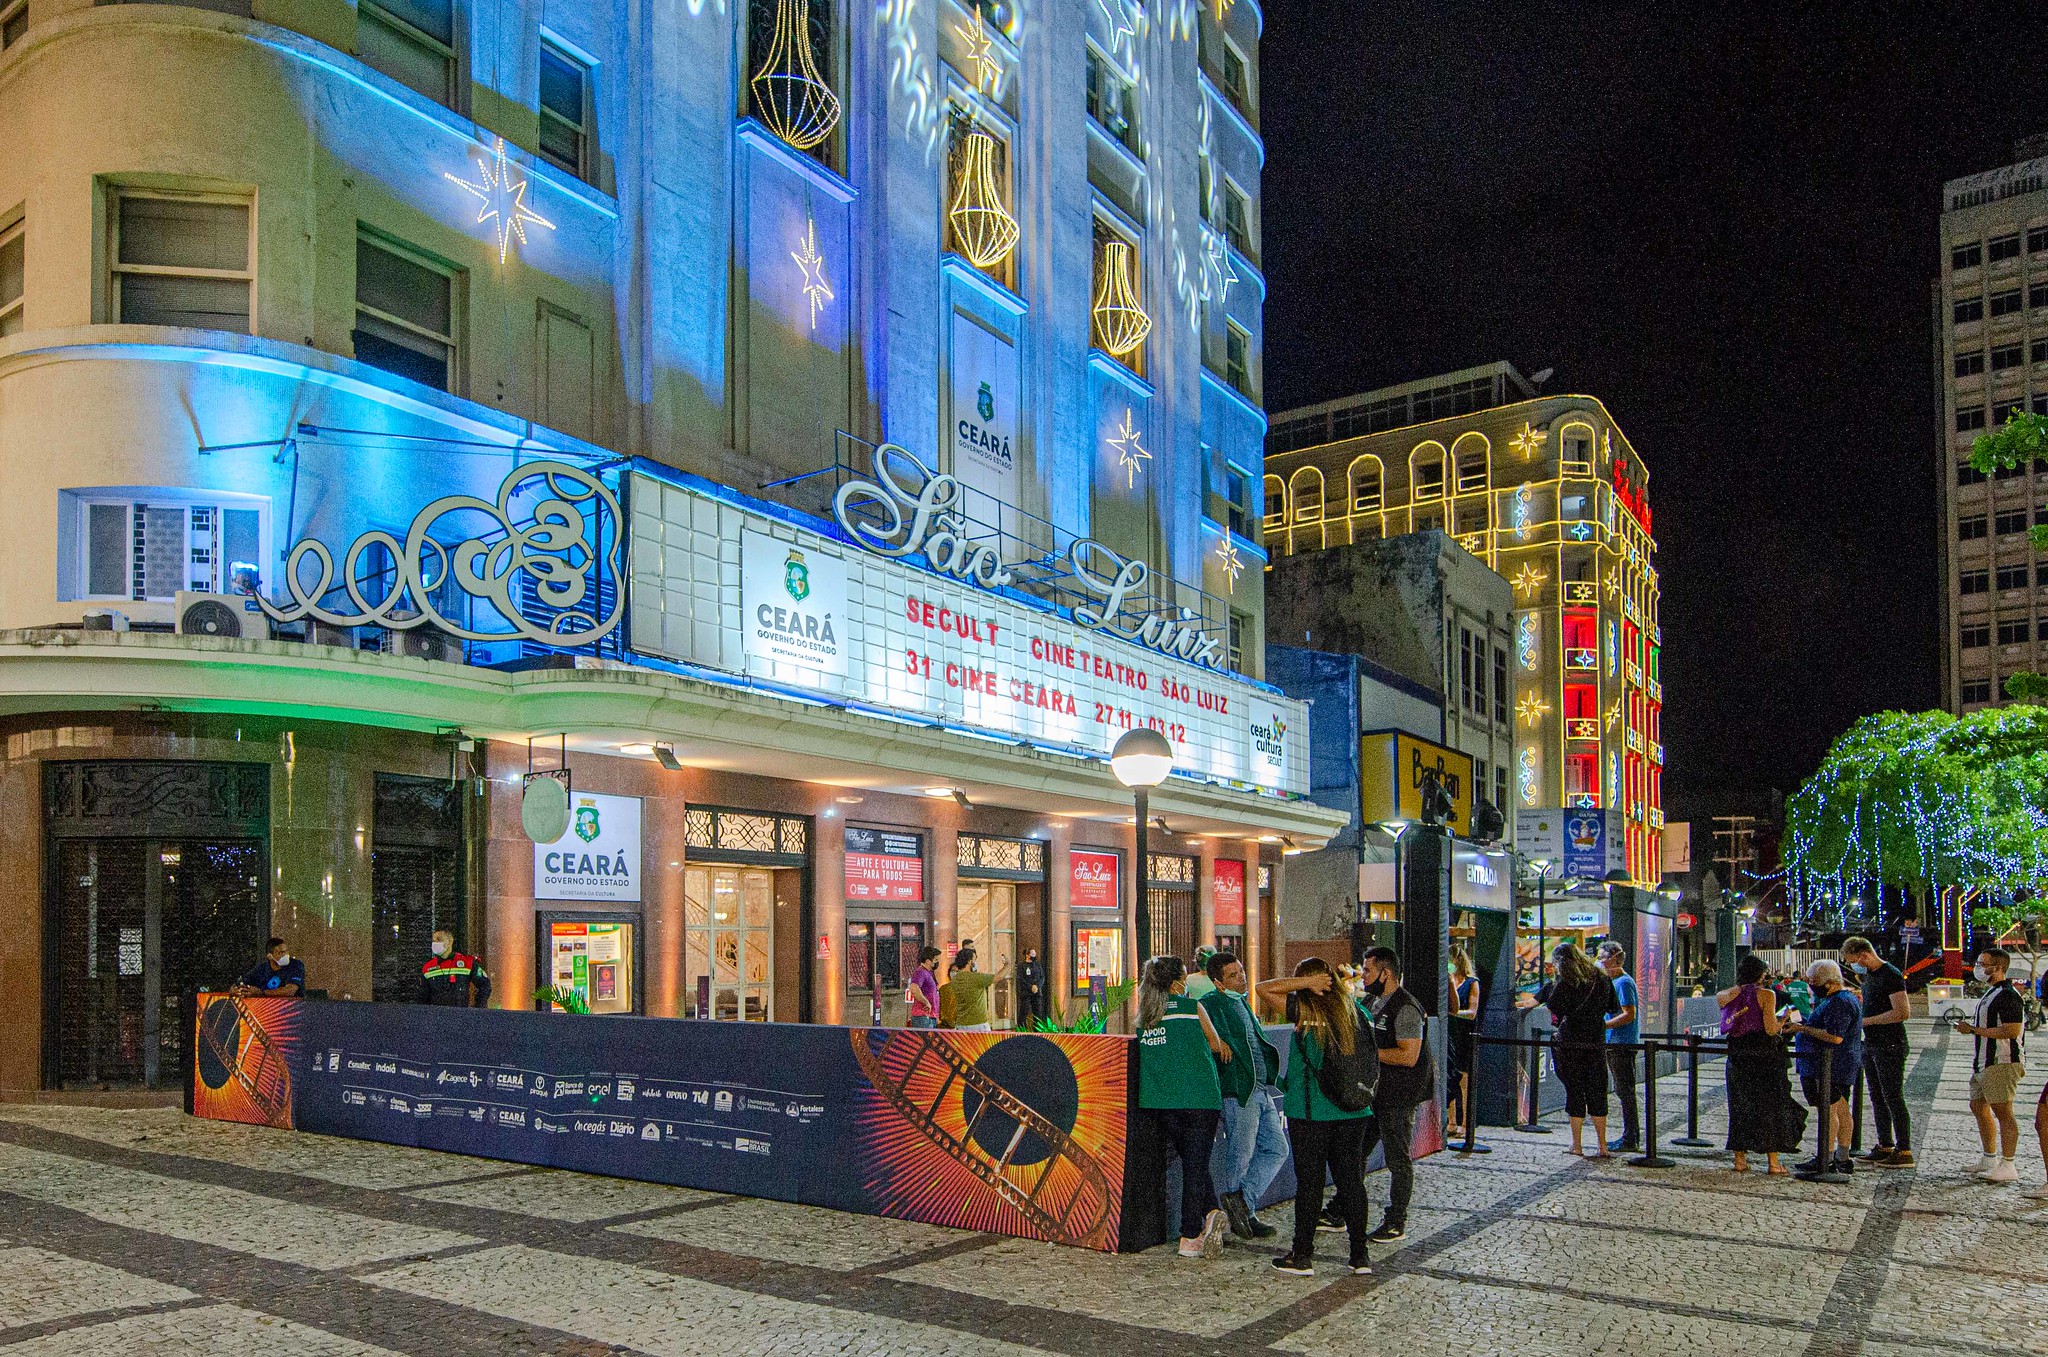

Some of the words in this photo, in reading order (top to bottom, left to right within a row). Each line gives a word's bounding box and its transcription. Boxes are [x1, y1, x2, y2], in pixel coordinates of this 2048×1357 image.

[958, 420, 1012, 462] CEARÁ
[958, 440, 984, 457] GOVERNO
[984, 452, 993, 461] DO
[993, 457, 1013, 471] ESTADO
[832, 443, 1010, 588] São
[1068, 537, 1224, 669] Luiz
[757, 603, 837, 646] CEARÁ
[757, 629, 795, 646] GOVERNO
[796, 638, 808, 649] DO
[809, 642, 837, 656] ESTADO
[771, 647, 798, 659] SECRETARIA
[804, 654, 825, 665] CULTURA
[906, 597, 999, 646] SECULT
[1161, 675, 1190, 703] SÃO
[1197, 689, 1228, 714] LUIZ
[945, 662, 998, 697] CINE
[1250, 723, 1271, 740] ceará
[1256, 739, 1283, 757] cultura
[1267, 755, 1282, 767] SECULT
[544, 848, 629, 877] CEARÁ
[857, 857, 872, 868] ARTE
[875, 859, 879, 868] E
[881, 859, 909, 871] CULTURA
[544, 876, 585, 886] GOVERNO
[586, 878, 598, 886] DO
[600, 878, 630, 887] ESTADO
[863, 869, 880, 879] PARA
[882, 870, 903, 881] TODOS
[1466, 863, 1498, 887] ENTRADA
[1140, 1036, 1167, 1046] AGEFIS
[1142, 1027, 1166, 1038] APOIO
[446, 1073, 468, 1084] Cagece
[497, 1073, 524, 1085] CEARÁ
[588, 1082, 611, 1096] enel
[800, 1104, 824, 1112] Fortaleza
[499, 1111, 526, 1123] CEARÁ
[609, 1121, 635, 1135] Diário
[748, 1144, 770, 1153] BRASIL
